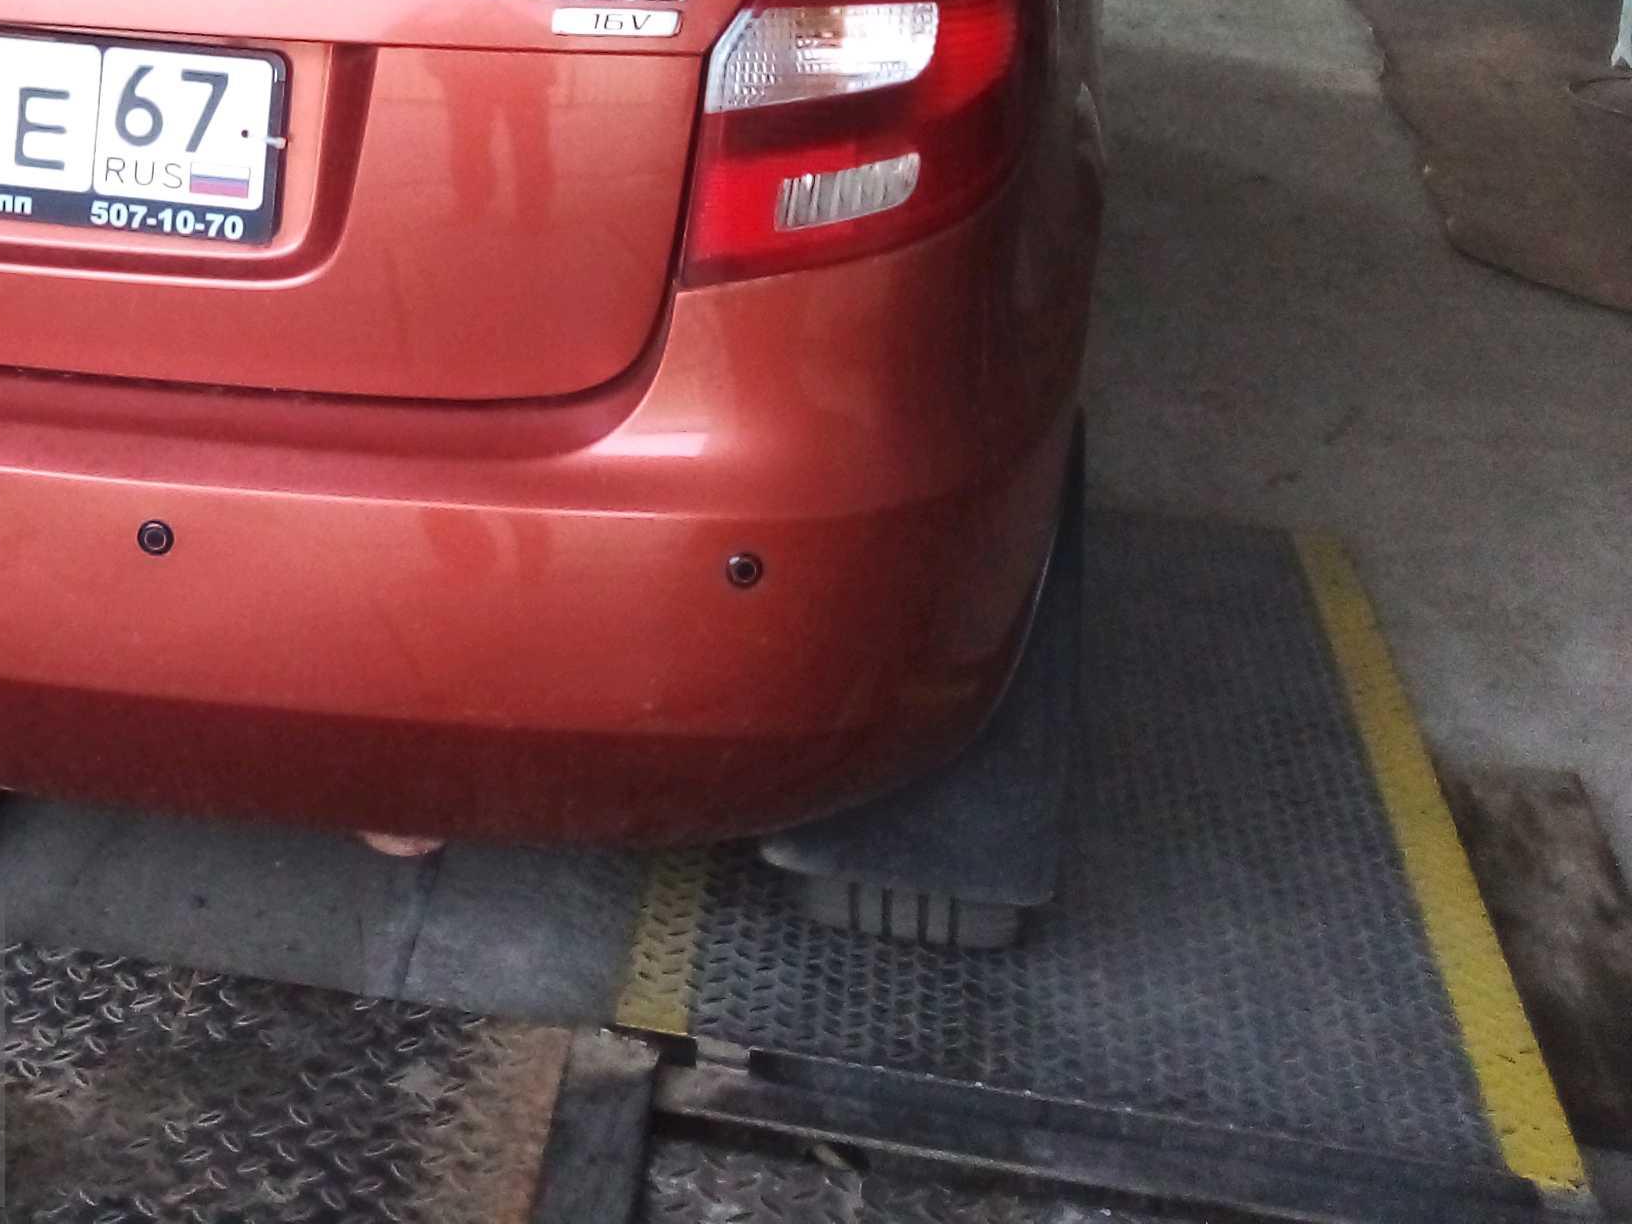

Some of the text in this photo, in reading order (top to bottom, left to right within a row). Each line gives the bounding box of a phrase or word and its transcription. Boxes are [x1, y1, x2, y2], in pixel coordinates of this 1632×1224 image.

[593, 13, 652, 31] 16V
[114, 65, 230, 153] 67
[104, 157, 183, 191] RUS
[90, 200, 245, 241] 507-10-70
